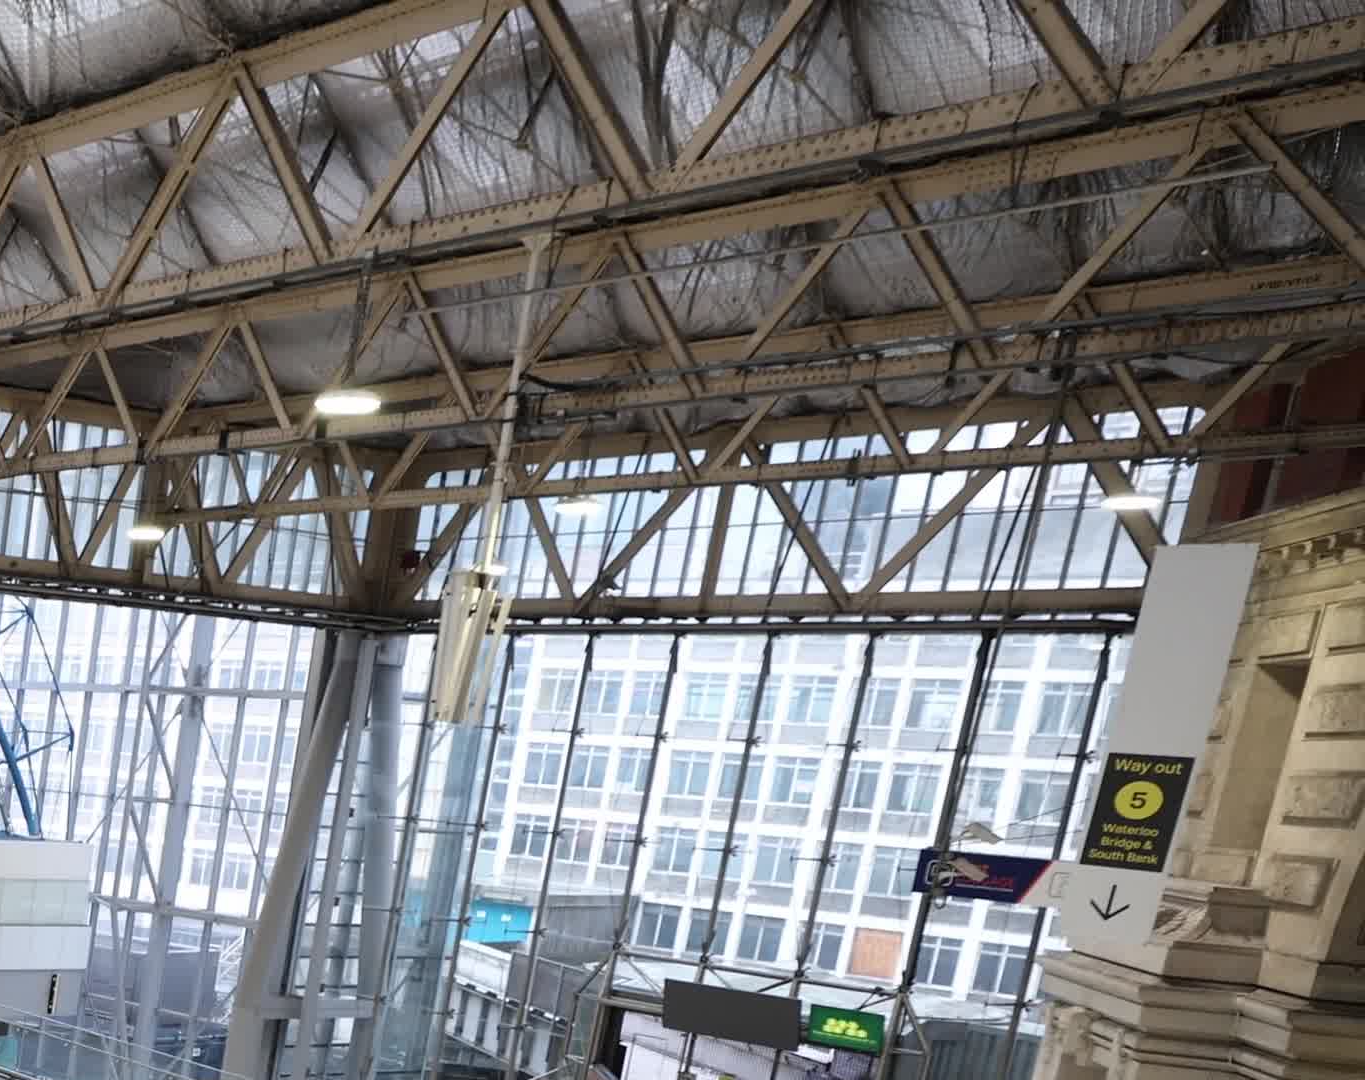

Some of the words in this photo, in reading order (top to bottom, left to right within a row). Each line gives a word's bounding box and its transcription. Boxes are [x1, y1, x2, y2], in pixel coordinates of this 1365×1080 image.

[1114, 758, 1152, 776] Way
[1154, 762, 1184, 775] out
[1129, 791, 1149, 810] 5
[1101, 823, 1159, 837] Waterloo
[1100, 836, 1142, 851] Bridge
[1144, 840, 1154, 850] &
[1087, 848, 1126, 861] South
[1125, 852, 1159, 864] Bank
